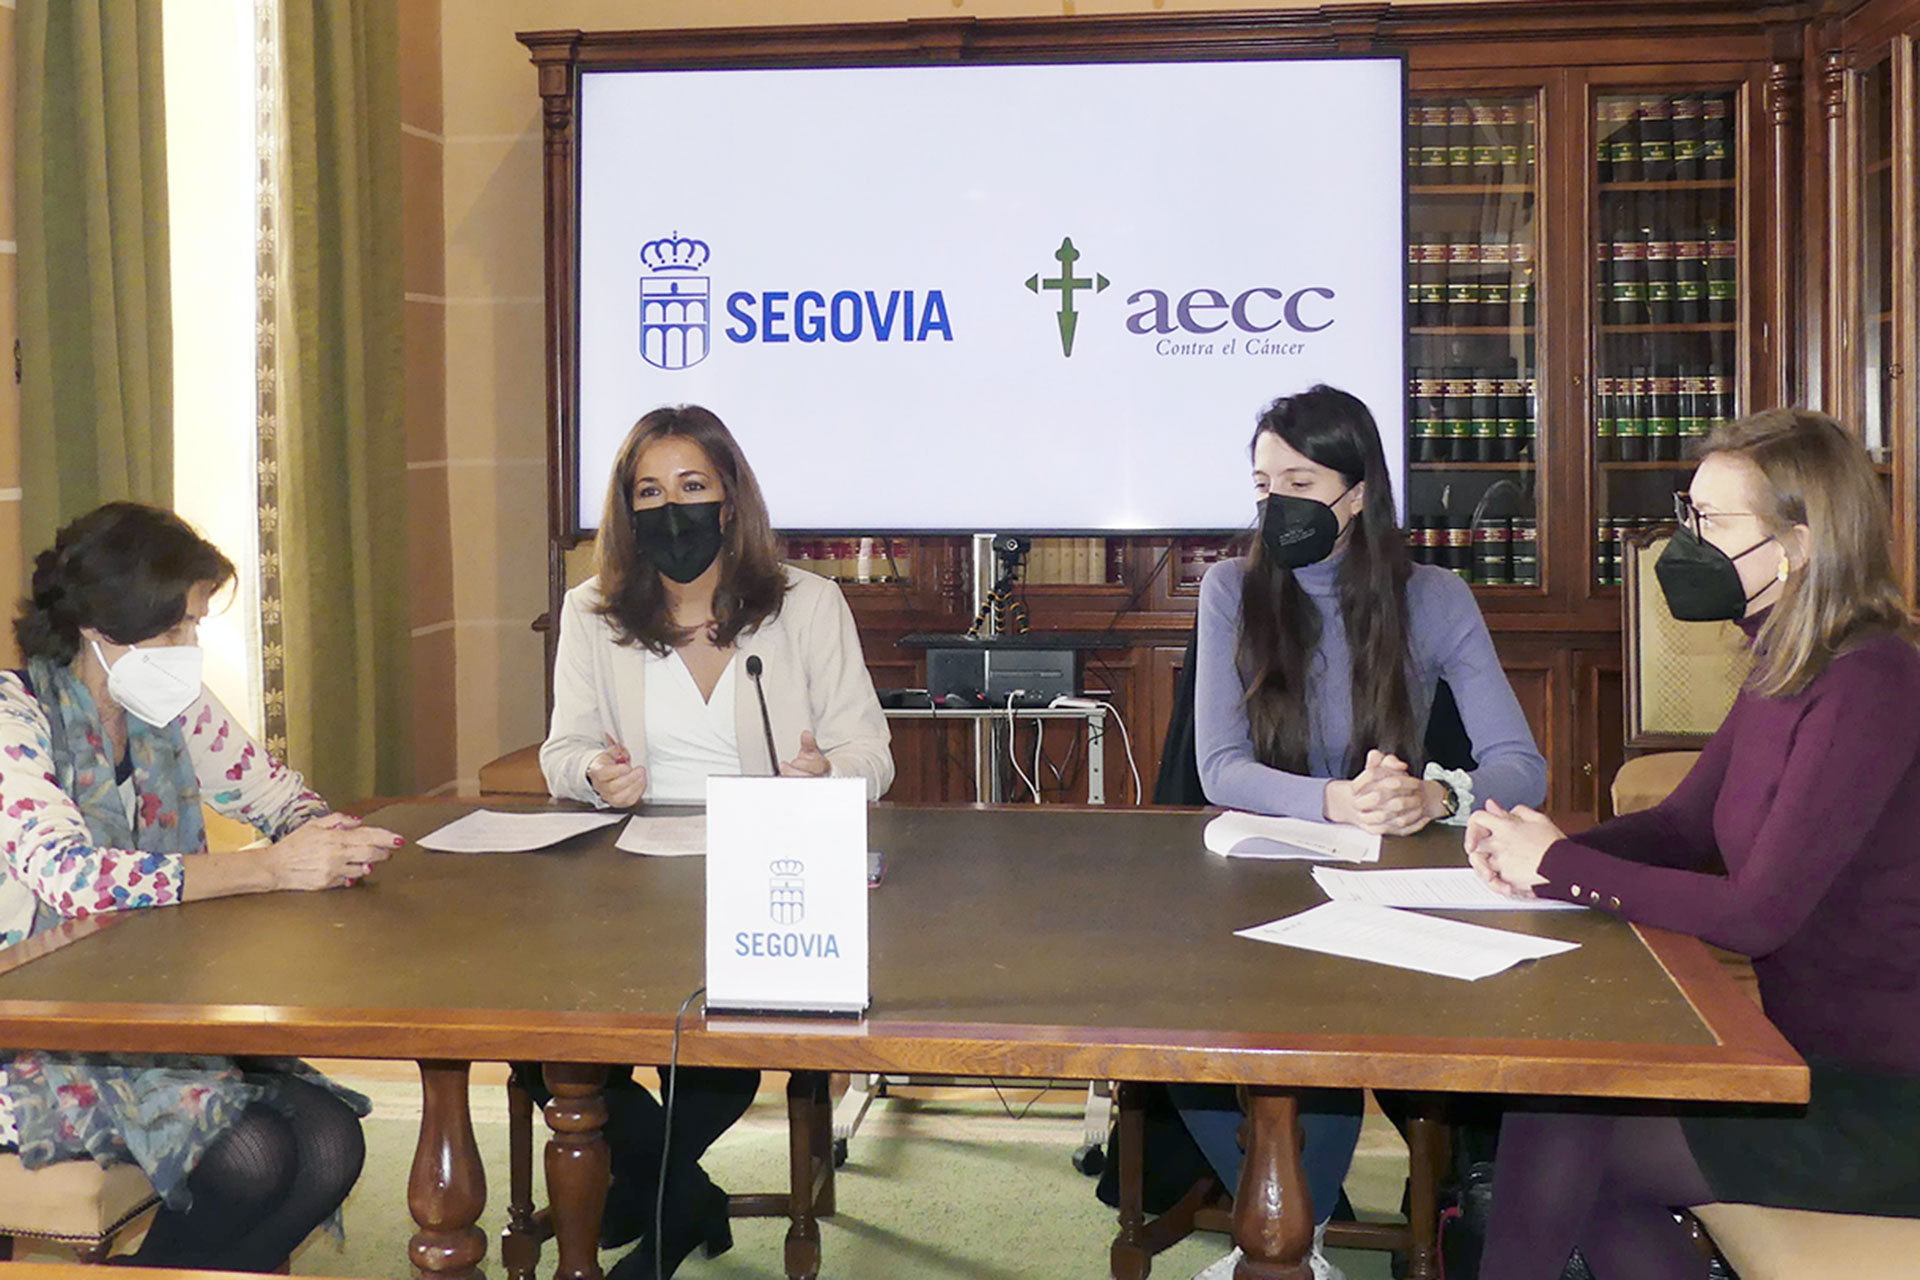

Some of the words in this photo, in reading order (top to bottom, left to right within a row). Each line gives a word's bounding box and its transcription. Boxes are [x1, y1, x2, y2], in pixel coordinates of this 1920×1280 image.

[725, 290, 953, 343] SEGOVIA
[1126, 287, 1335, 334] aecc
[1156, 339, 1213, 355] Contra
[1222, 339, 1236, 355] el
[1245, 339, 1305, 355] Cáncer
[735, 933, 839, 958] SEGOVIA
